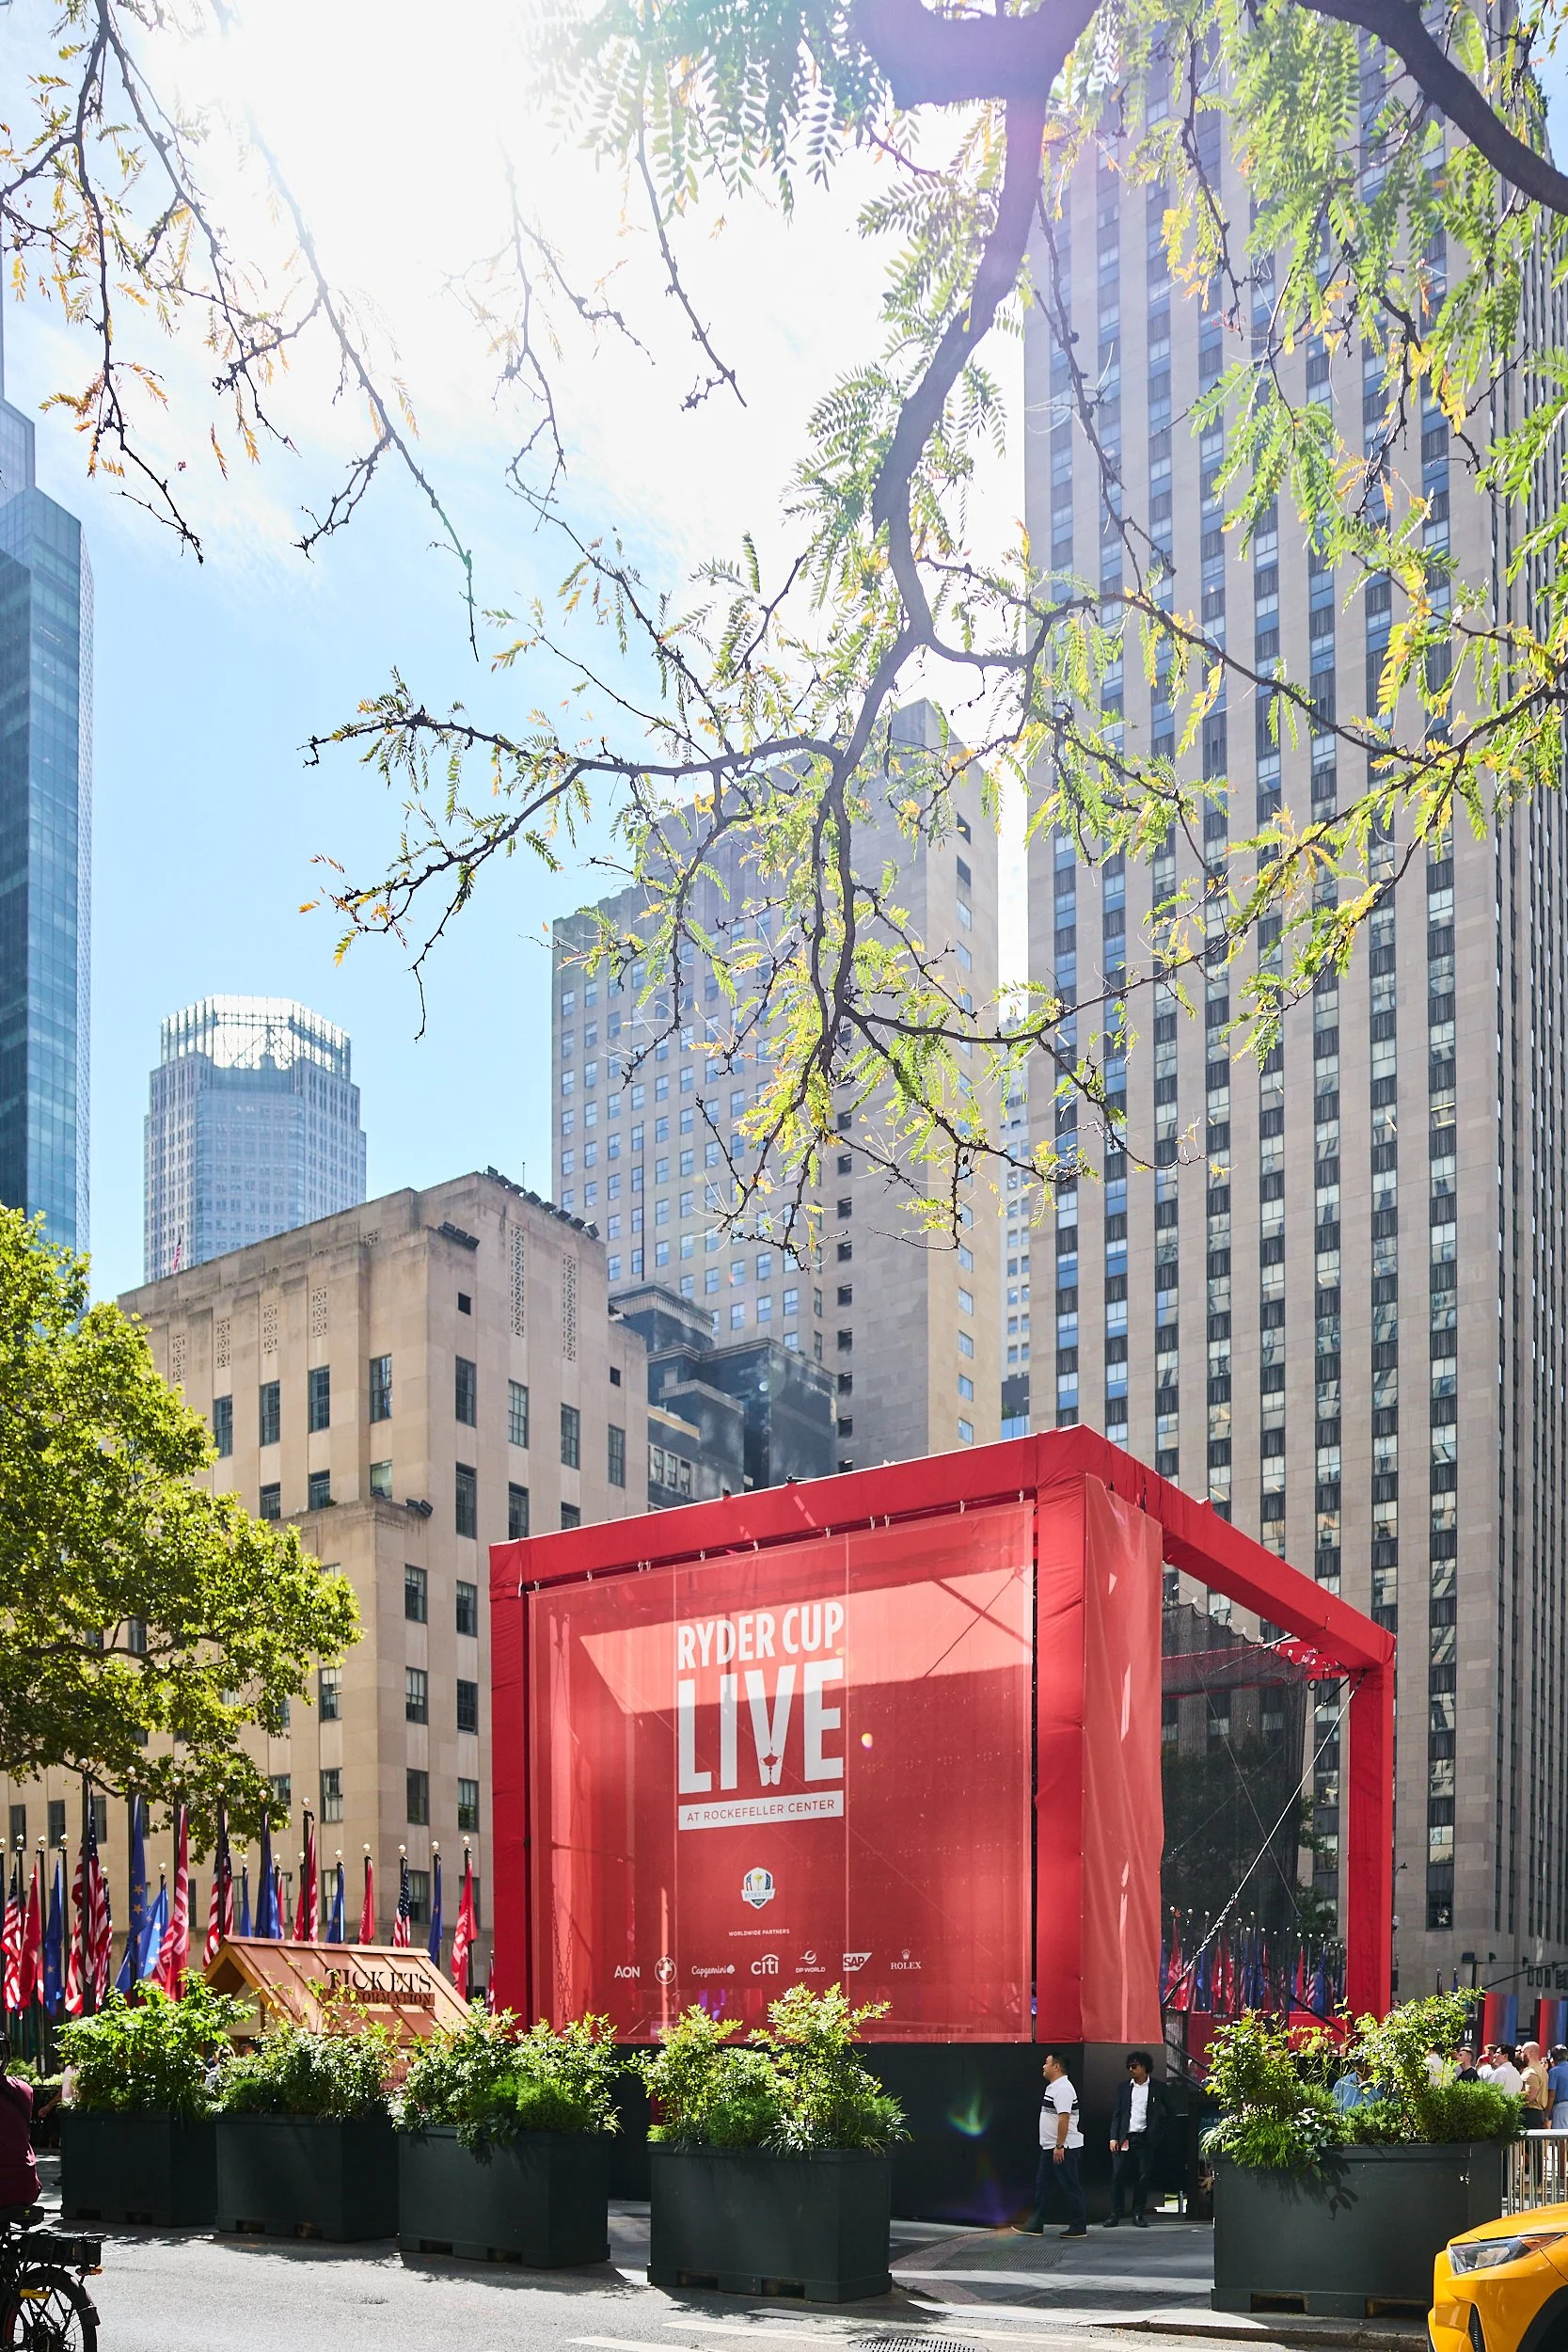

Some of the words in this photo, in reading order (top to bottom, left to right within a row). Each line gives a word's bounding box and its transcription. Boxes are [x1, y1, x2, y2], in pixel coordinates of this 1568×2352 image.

[678, 1613, 776, 1671] RYDER
[782, 1601, 845, 1656] CUP
[678, 1658, 844, 1794] LIVE
[687, 1812, 700, 1821] AT
[704, 1804, 784, 1820] ROCKEFELLER
[787, 1799, 835, 1813] CENTER
[613, 1964, 641, 1979] AON
[691, 1964, 727, 1979] Capgemini
[751, 1953, 780, 1975] citi
[844, 1956, 865, 1968] SAP
[890, 1962, 922, 1970] ROLEX
[325, 1968, 432, 1993] TICKETS
